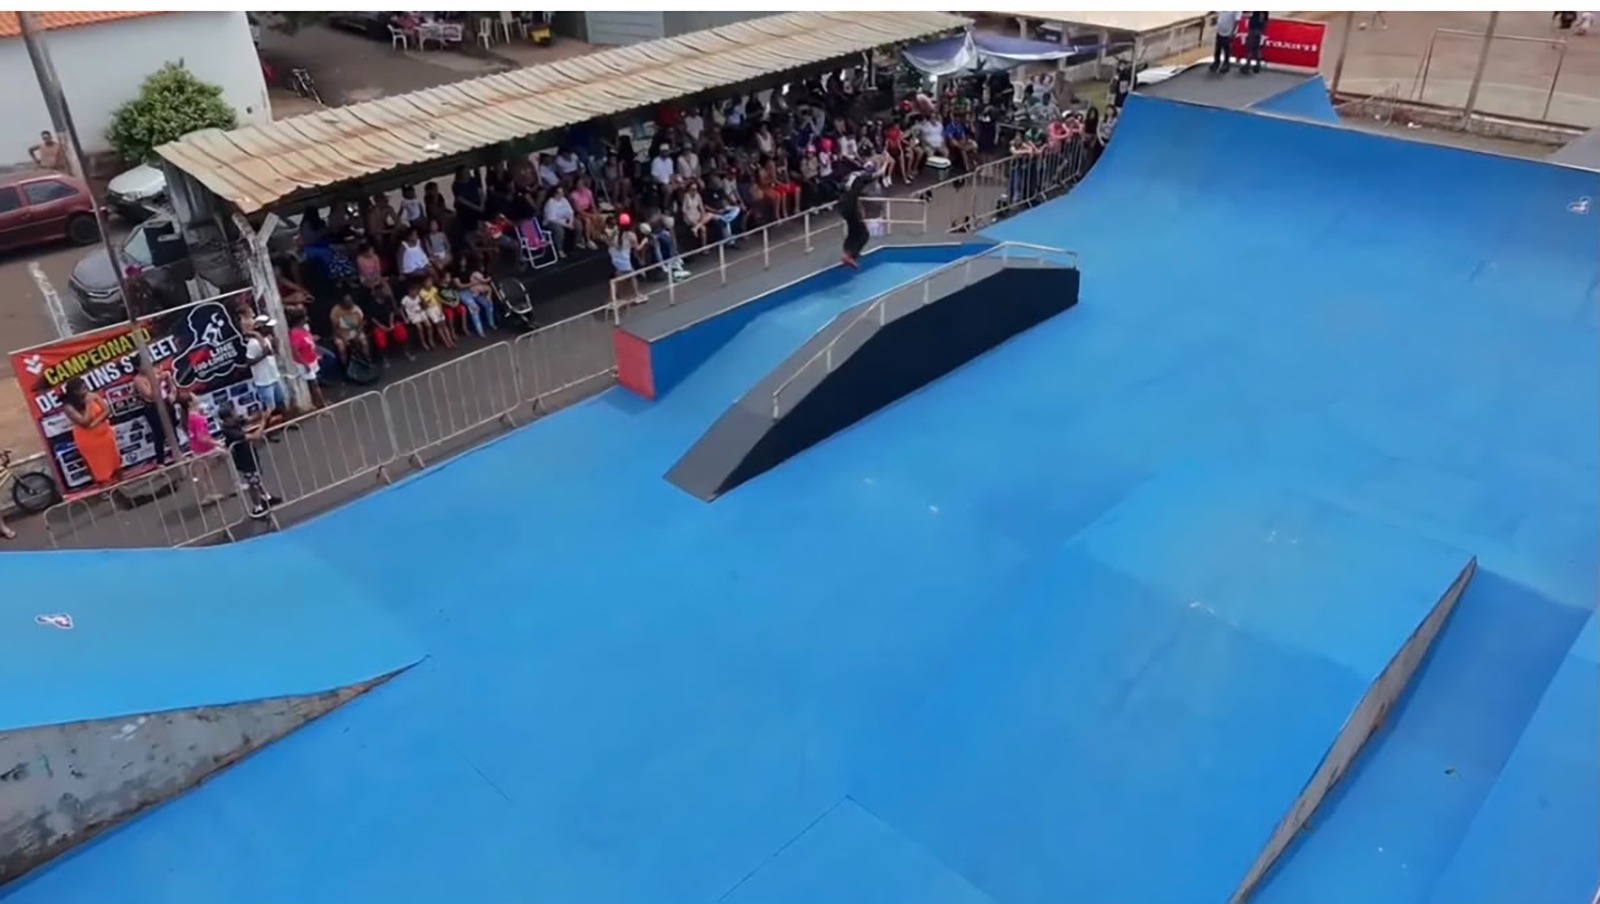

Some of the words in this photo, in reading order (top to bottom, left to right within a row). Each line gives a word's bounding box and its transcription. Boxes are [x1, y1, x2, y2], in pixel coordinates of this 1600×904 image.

[35, 390, 63, 413] DE
[120, 334, 178, 374] SEET
[44, 328, 151, 385] CAMPEONATO
